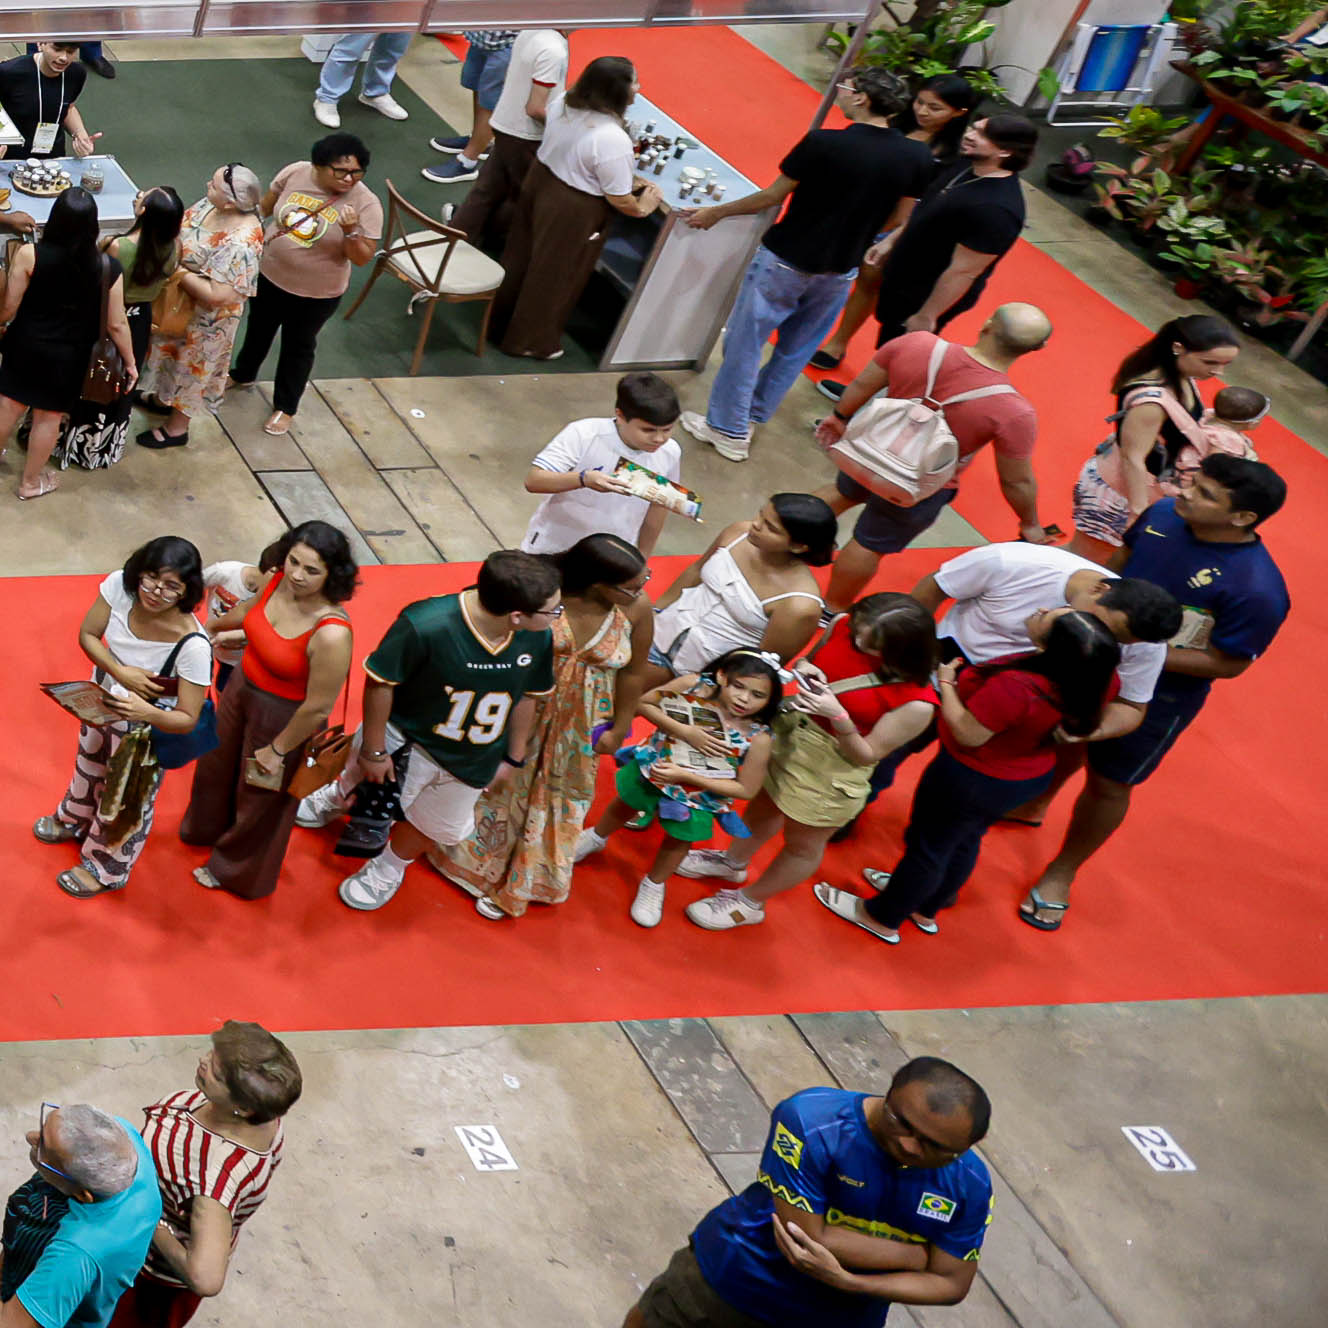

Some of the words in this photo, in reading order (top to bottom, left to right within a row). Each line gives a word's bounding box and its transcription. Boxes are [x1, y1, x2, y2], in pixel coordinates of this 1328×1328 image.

[466, 662, 494, 670] GREEN
[461, 1126, 509, 1170] 24
[1129, 1128, 1188, 1170] 25
